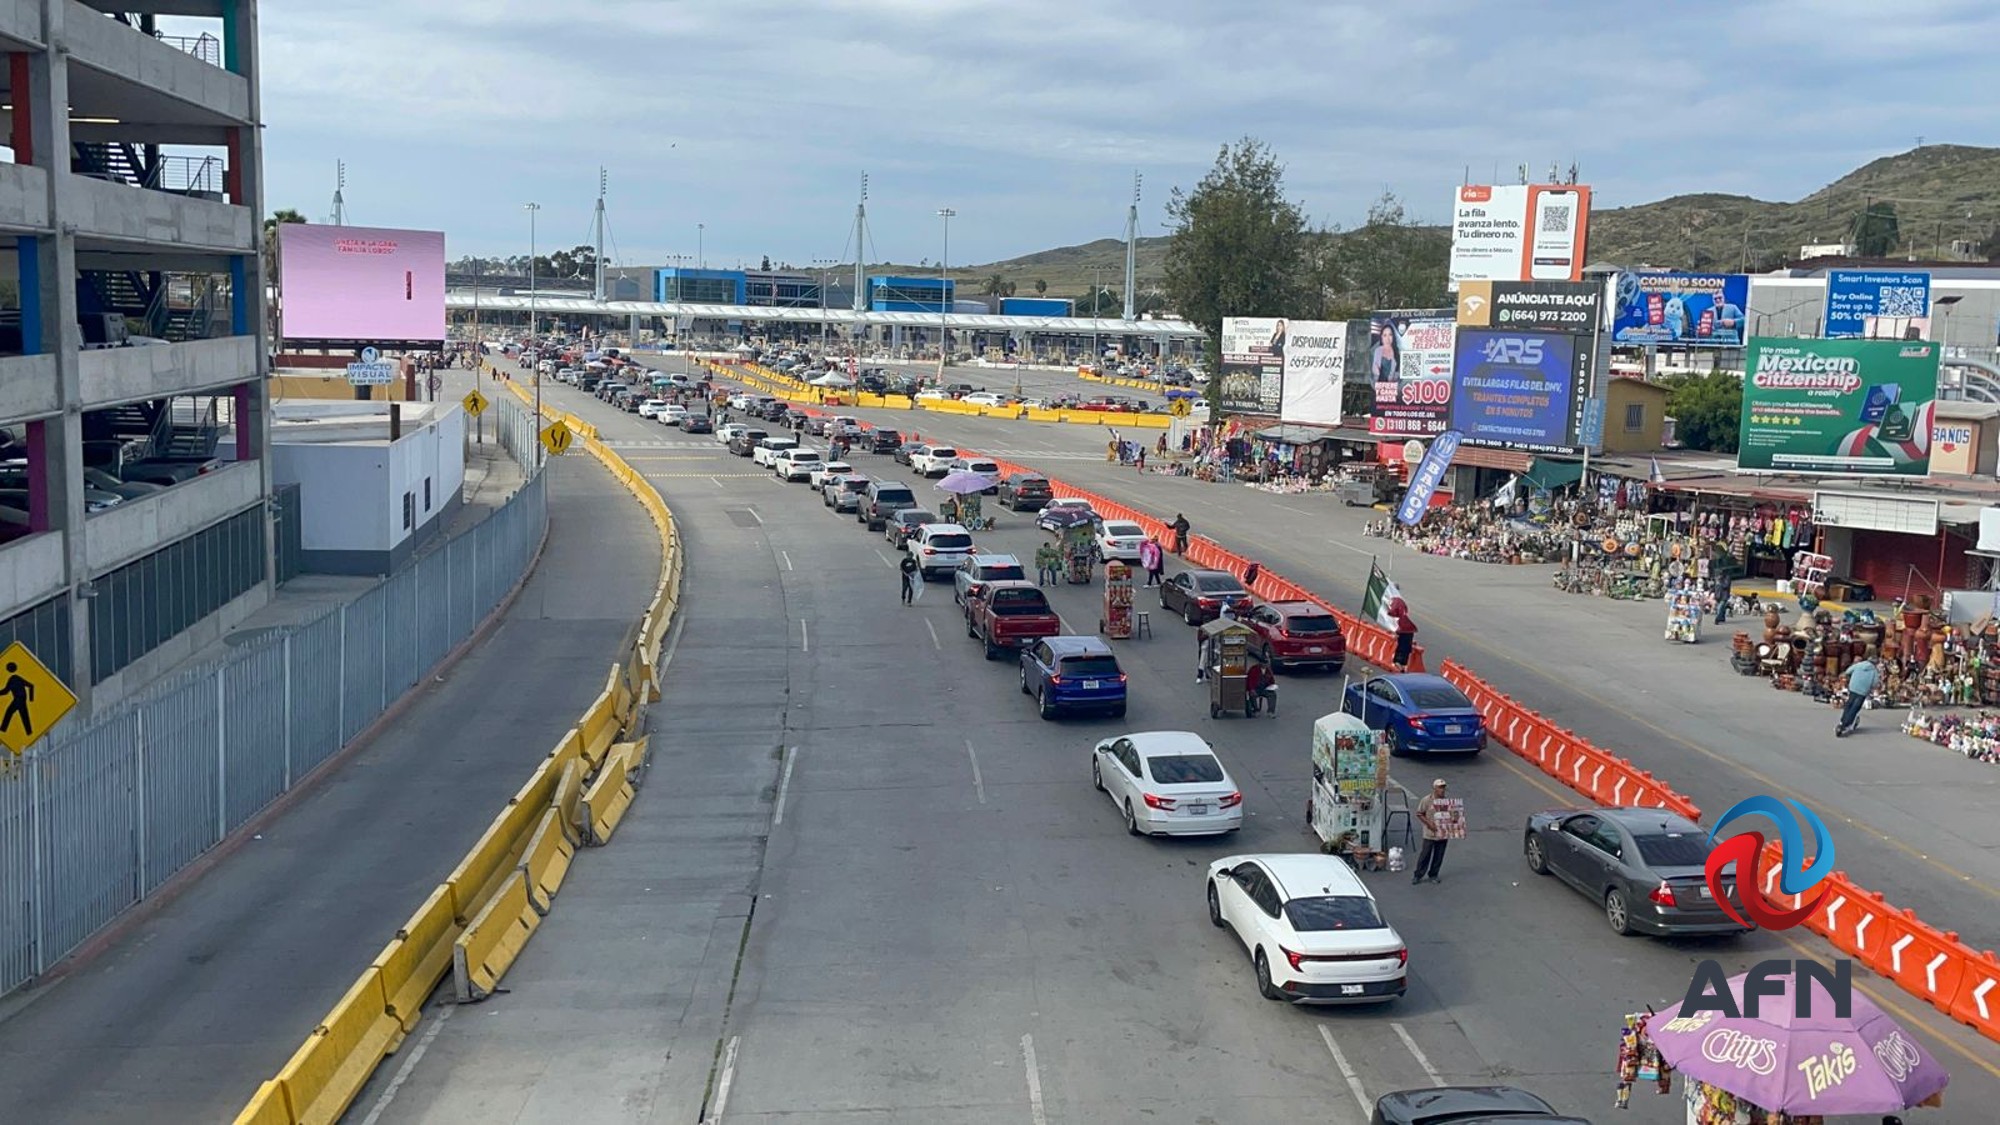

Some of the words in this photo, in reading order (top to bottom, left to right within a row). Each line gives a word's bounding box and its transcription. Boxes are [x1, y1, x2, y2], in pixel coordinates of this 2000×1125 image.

[1463, 189, 1477, 198] ria
[1459, 209, 1470, 217] La
[1471, 209, 1486, 217] fila
[1458, 220, 1492, 228] avanza
[1493, 220, 1520, 228] lento.
[1458, 230, 1470, 238] Tu
[1471, 230, 1501, 238] dinero
[1502, 231, 1517, 239] no.
[1640, 276, 1689, 287] COMING
[1691, 278, 1726, 288] SOON
[1838, 274, 1863, 282] Smart
[1865, 274, 1900, 283] Investors
[1902, 276, 1922, 284] Scan
[1498, 292, 1564, 306] ANÚNCIATE
[1566, 294, 1596, 306] AQUÍ
[1832, 293, 1846, 302] Buy
[1512, 310, 1537, 322] (664)
[1540, 312, 1558, 321] 973
[1560, 312, 1586, 322] 2200
[1830, 312, 1852, 320] 50%
[1291, 336, 1340, 349] DISPONIBLE
[1486, 338, 1545, 364] ARS
[1758, 352, 1857, 372] Mexican
[1463, 377, 1483, 387] EVITA
[1483, 378, 1509, 388] LARGAS
[1510, 379, 1530, 390] FILAS
[1530, 381, 1544, 391] DEL
[1545, 382, 1562, 393] DMV,
[1755, 371, 1860, 392] Citizenship
[1402, 380, 1450, 405] $100
[1575, 353, 1587, 435] DISPONIBLE
[1814, 389, 1842, 398] reality
[1507, 395, 1550, 407] COMPLETOS
[1501, 408, 1533, 418] MINUTOS
[1387, 418, 1406, 430] (310)
[1428, 421, 1446, 432] 6644
[1932, 426, 1970, 444] BAÑOS
[1798, 1041, 1856, 1100] Takis
